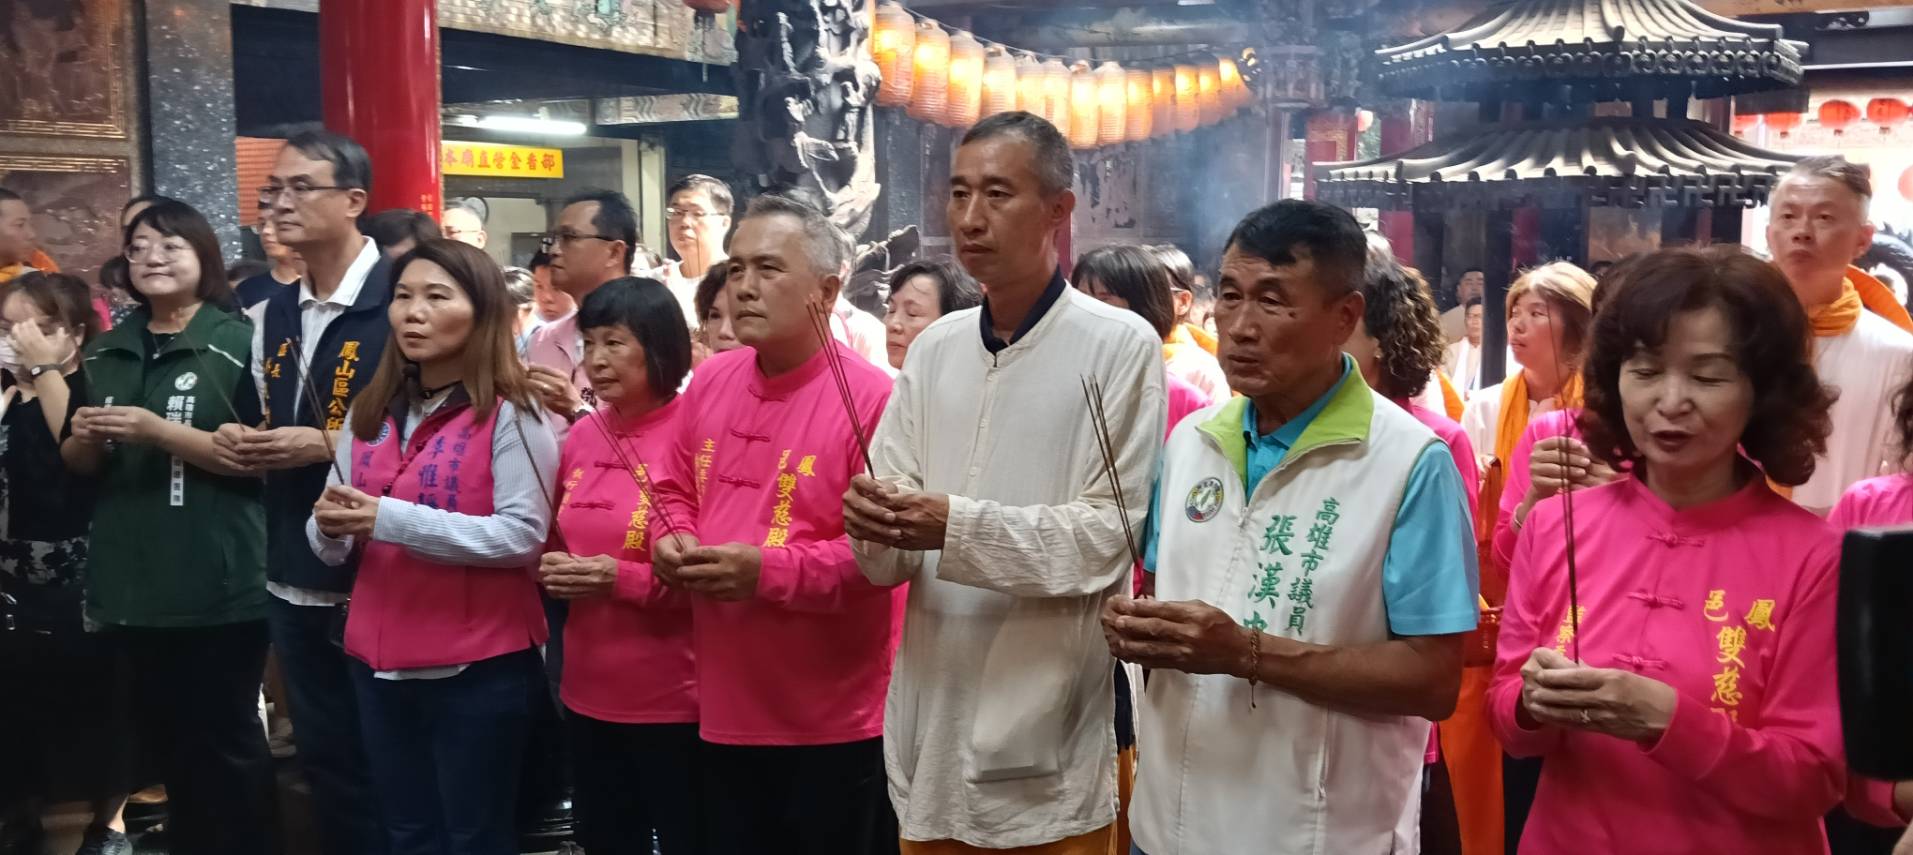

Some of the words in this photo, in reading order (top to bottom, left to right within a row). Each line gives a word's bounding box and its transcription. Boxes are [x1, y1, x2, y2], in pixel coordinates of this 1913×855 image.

[325, 341, 360, 430] 鳳山區公所
[1286, 497, 1341, 636] 高雄市議員
